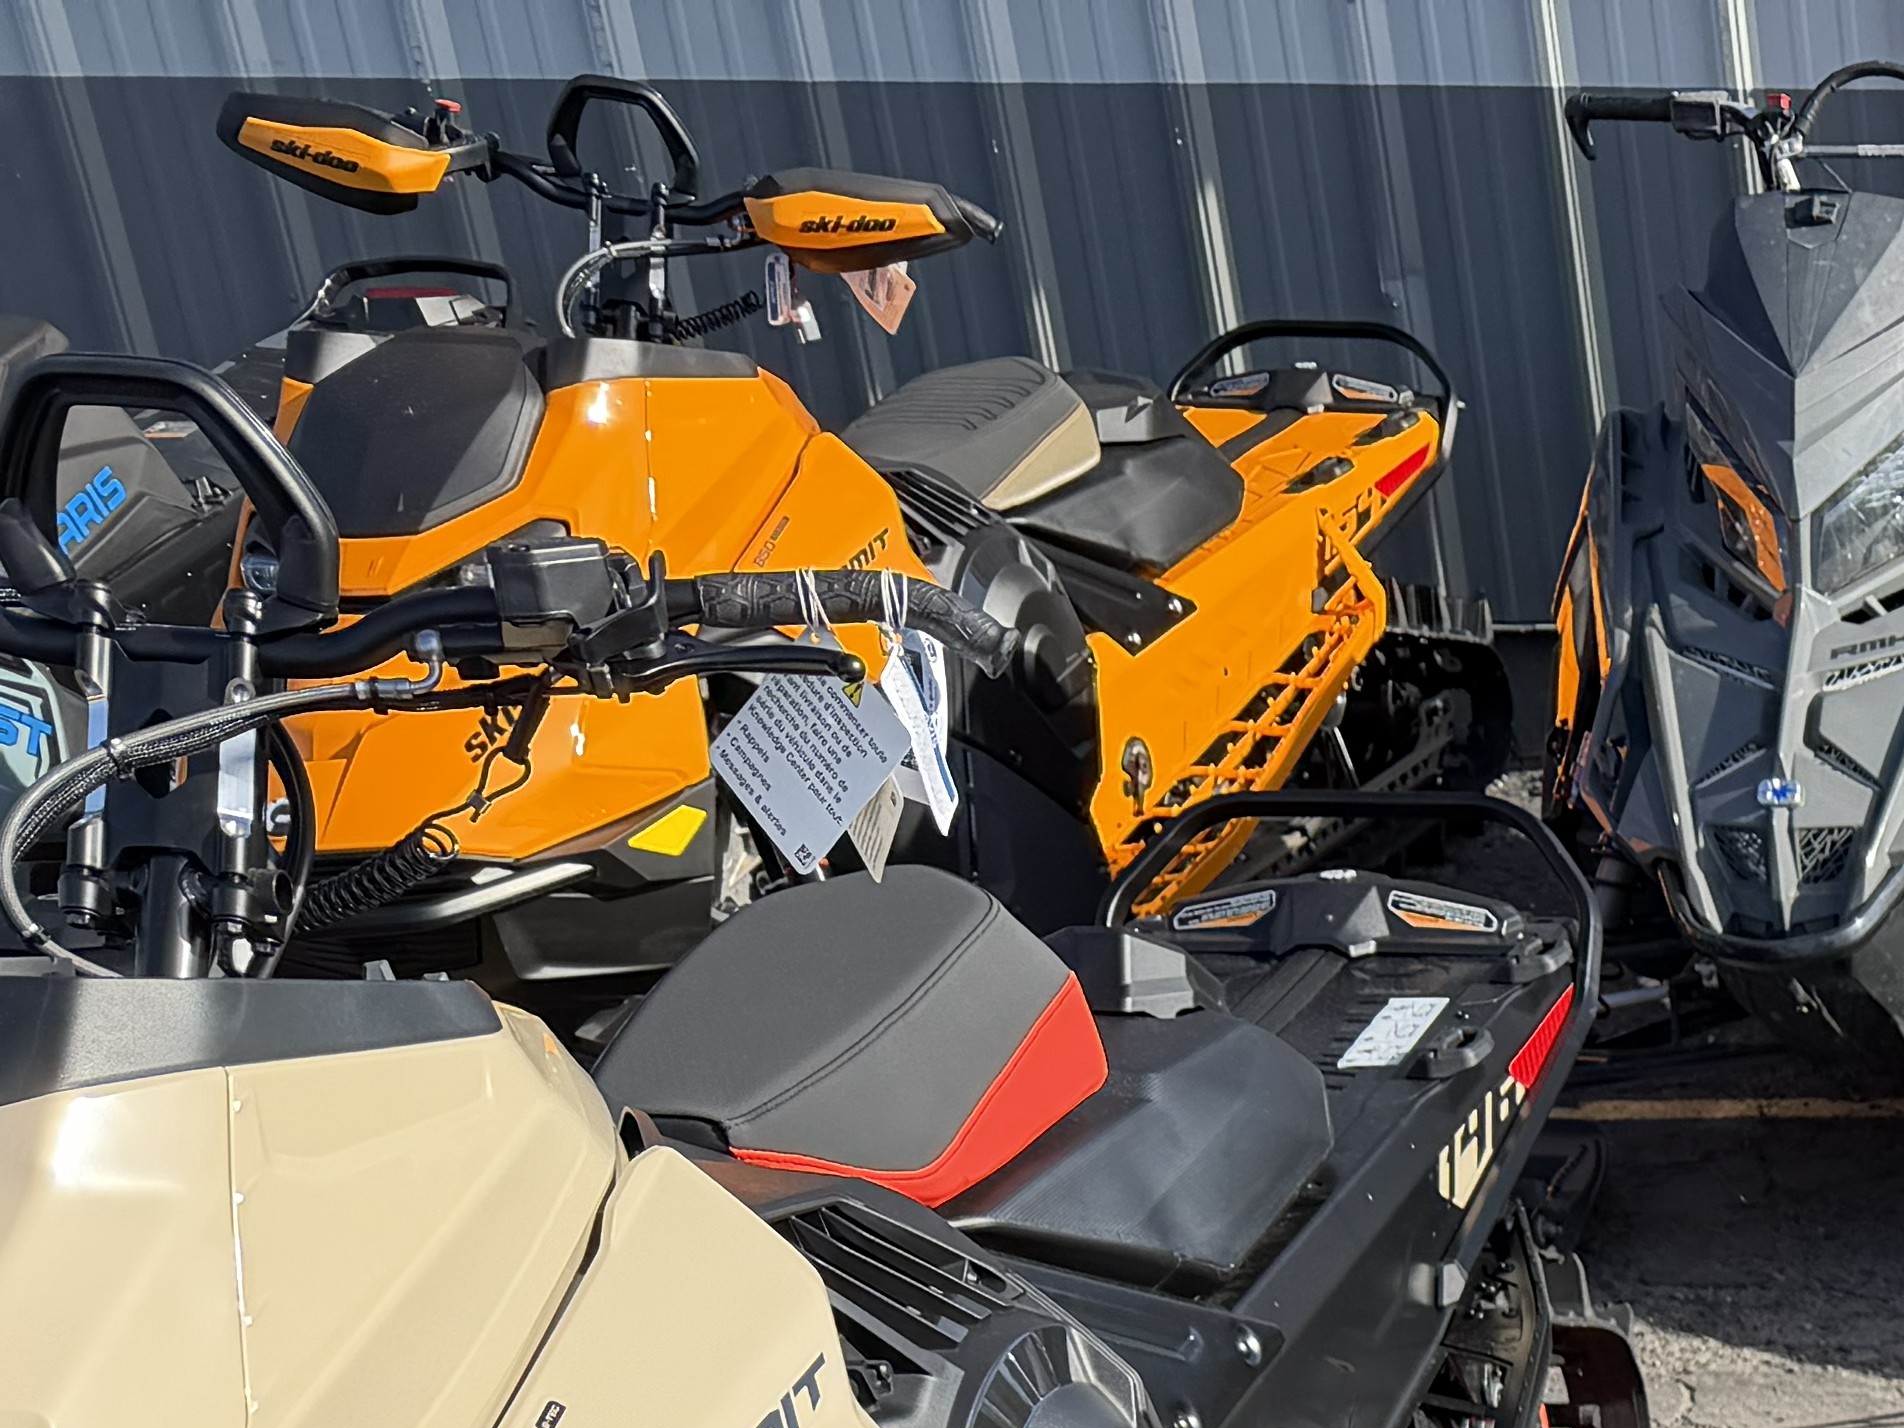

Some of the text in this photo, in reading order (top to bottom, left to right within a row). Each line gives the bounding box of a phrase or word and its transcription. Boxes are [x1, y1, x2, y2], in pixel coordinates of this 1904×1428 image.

[271, 139, 360, 173] ski-doo
[800, 195, 896, 233] ski-doo
[842, 528, 889, 570] MIT
[737, 723, 773, 764] Rappels
[762, 684, 803, 732] recherche
[798, 729, 813, 745] du
[836, 778, 851, 793] de
[798, 690, 834, 732] livraison
[830, 731, 843, 746] ou
[840, 743, 854, 758] de
[808, 722, 831, 747] faire
[825, 745, 844, 765] une
[716, 748, 758, 798] Messages
[727, 736, 775, 793] Campagnes
[745, 703, 789, 756] Knowledge
[784, 751, 812, 784] Center
[806, 781, 828, 806] pour
[773, 717, 787, 733] du
[813, 769, 836, 795] dans
[831, 791, 844, 805] le
